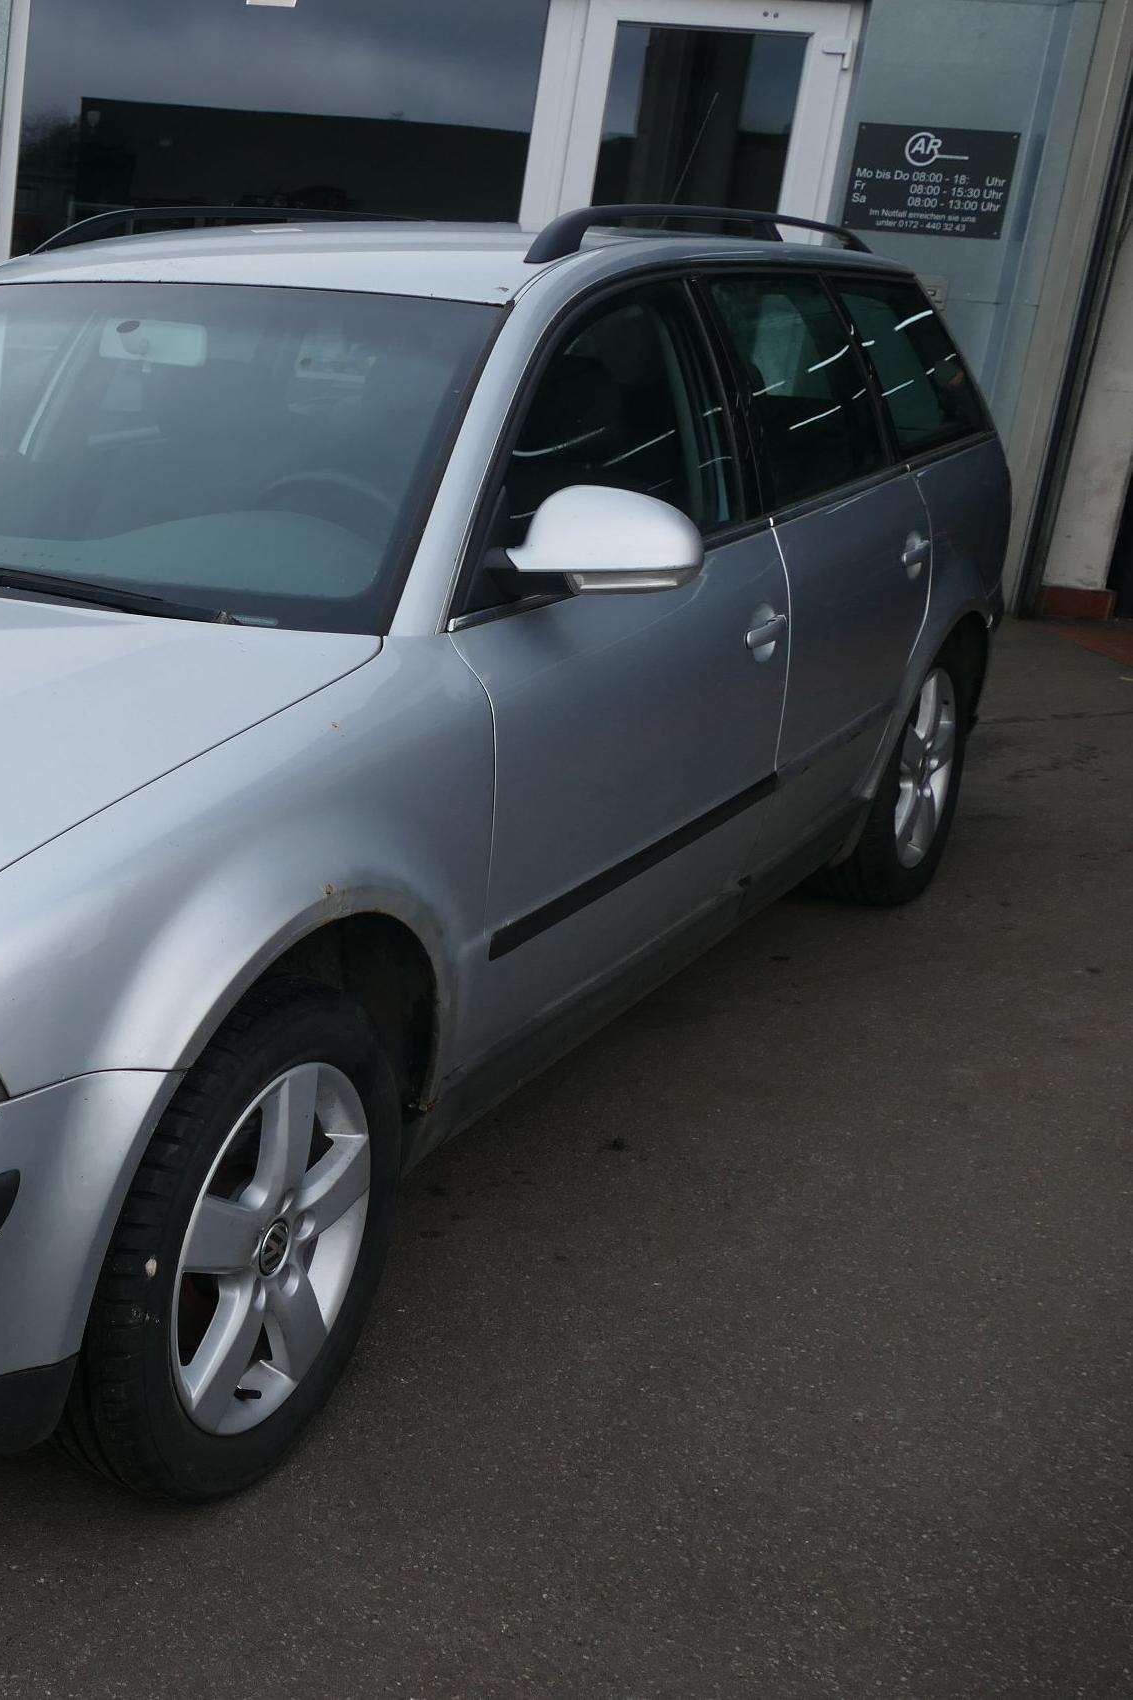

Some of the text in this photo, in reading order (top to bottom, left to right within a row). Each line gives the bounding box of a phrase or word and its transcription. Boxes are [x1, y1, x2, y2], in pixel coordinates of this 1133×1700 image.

[856, 168, 873, 178] Mo
[875, 169, 891, 179] bis
[894, 170, 910, 180] Do
[912, 171, 943, 183] 08:00
[986, 176, 1006, 187] Uhr
[854, 180, 866, 190] Fr
[910, 184, 941, 196] 08:00
[951, 187, 981, 198] 15:30
[983, 189, 1004, 200] Uhr
[851, 192, 867, 203] Sa
[907, 197, 938, 208] 08:00
[948, 200, 978, 211] 13:00
[981, 202, 1001, 212] Uhr
[869, 208, 880, 216] Im
[881, 209, 908, 218] Notfall
[908, 212, 946, 220] erreichen
[961, 215, 976, 223] uns
[875, 219, 898, 227] unter
[898, 220, 919, 229] 0172
